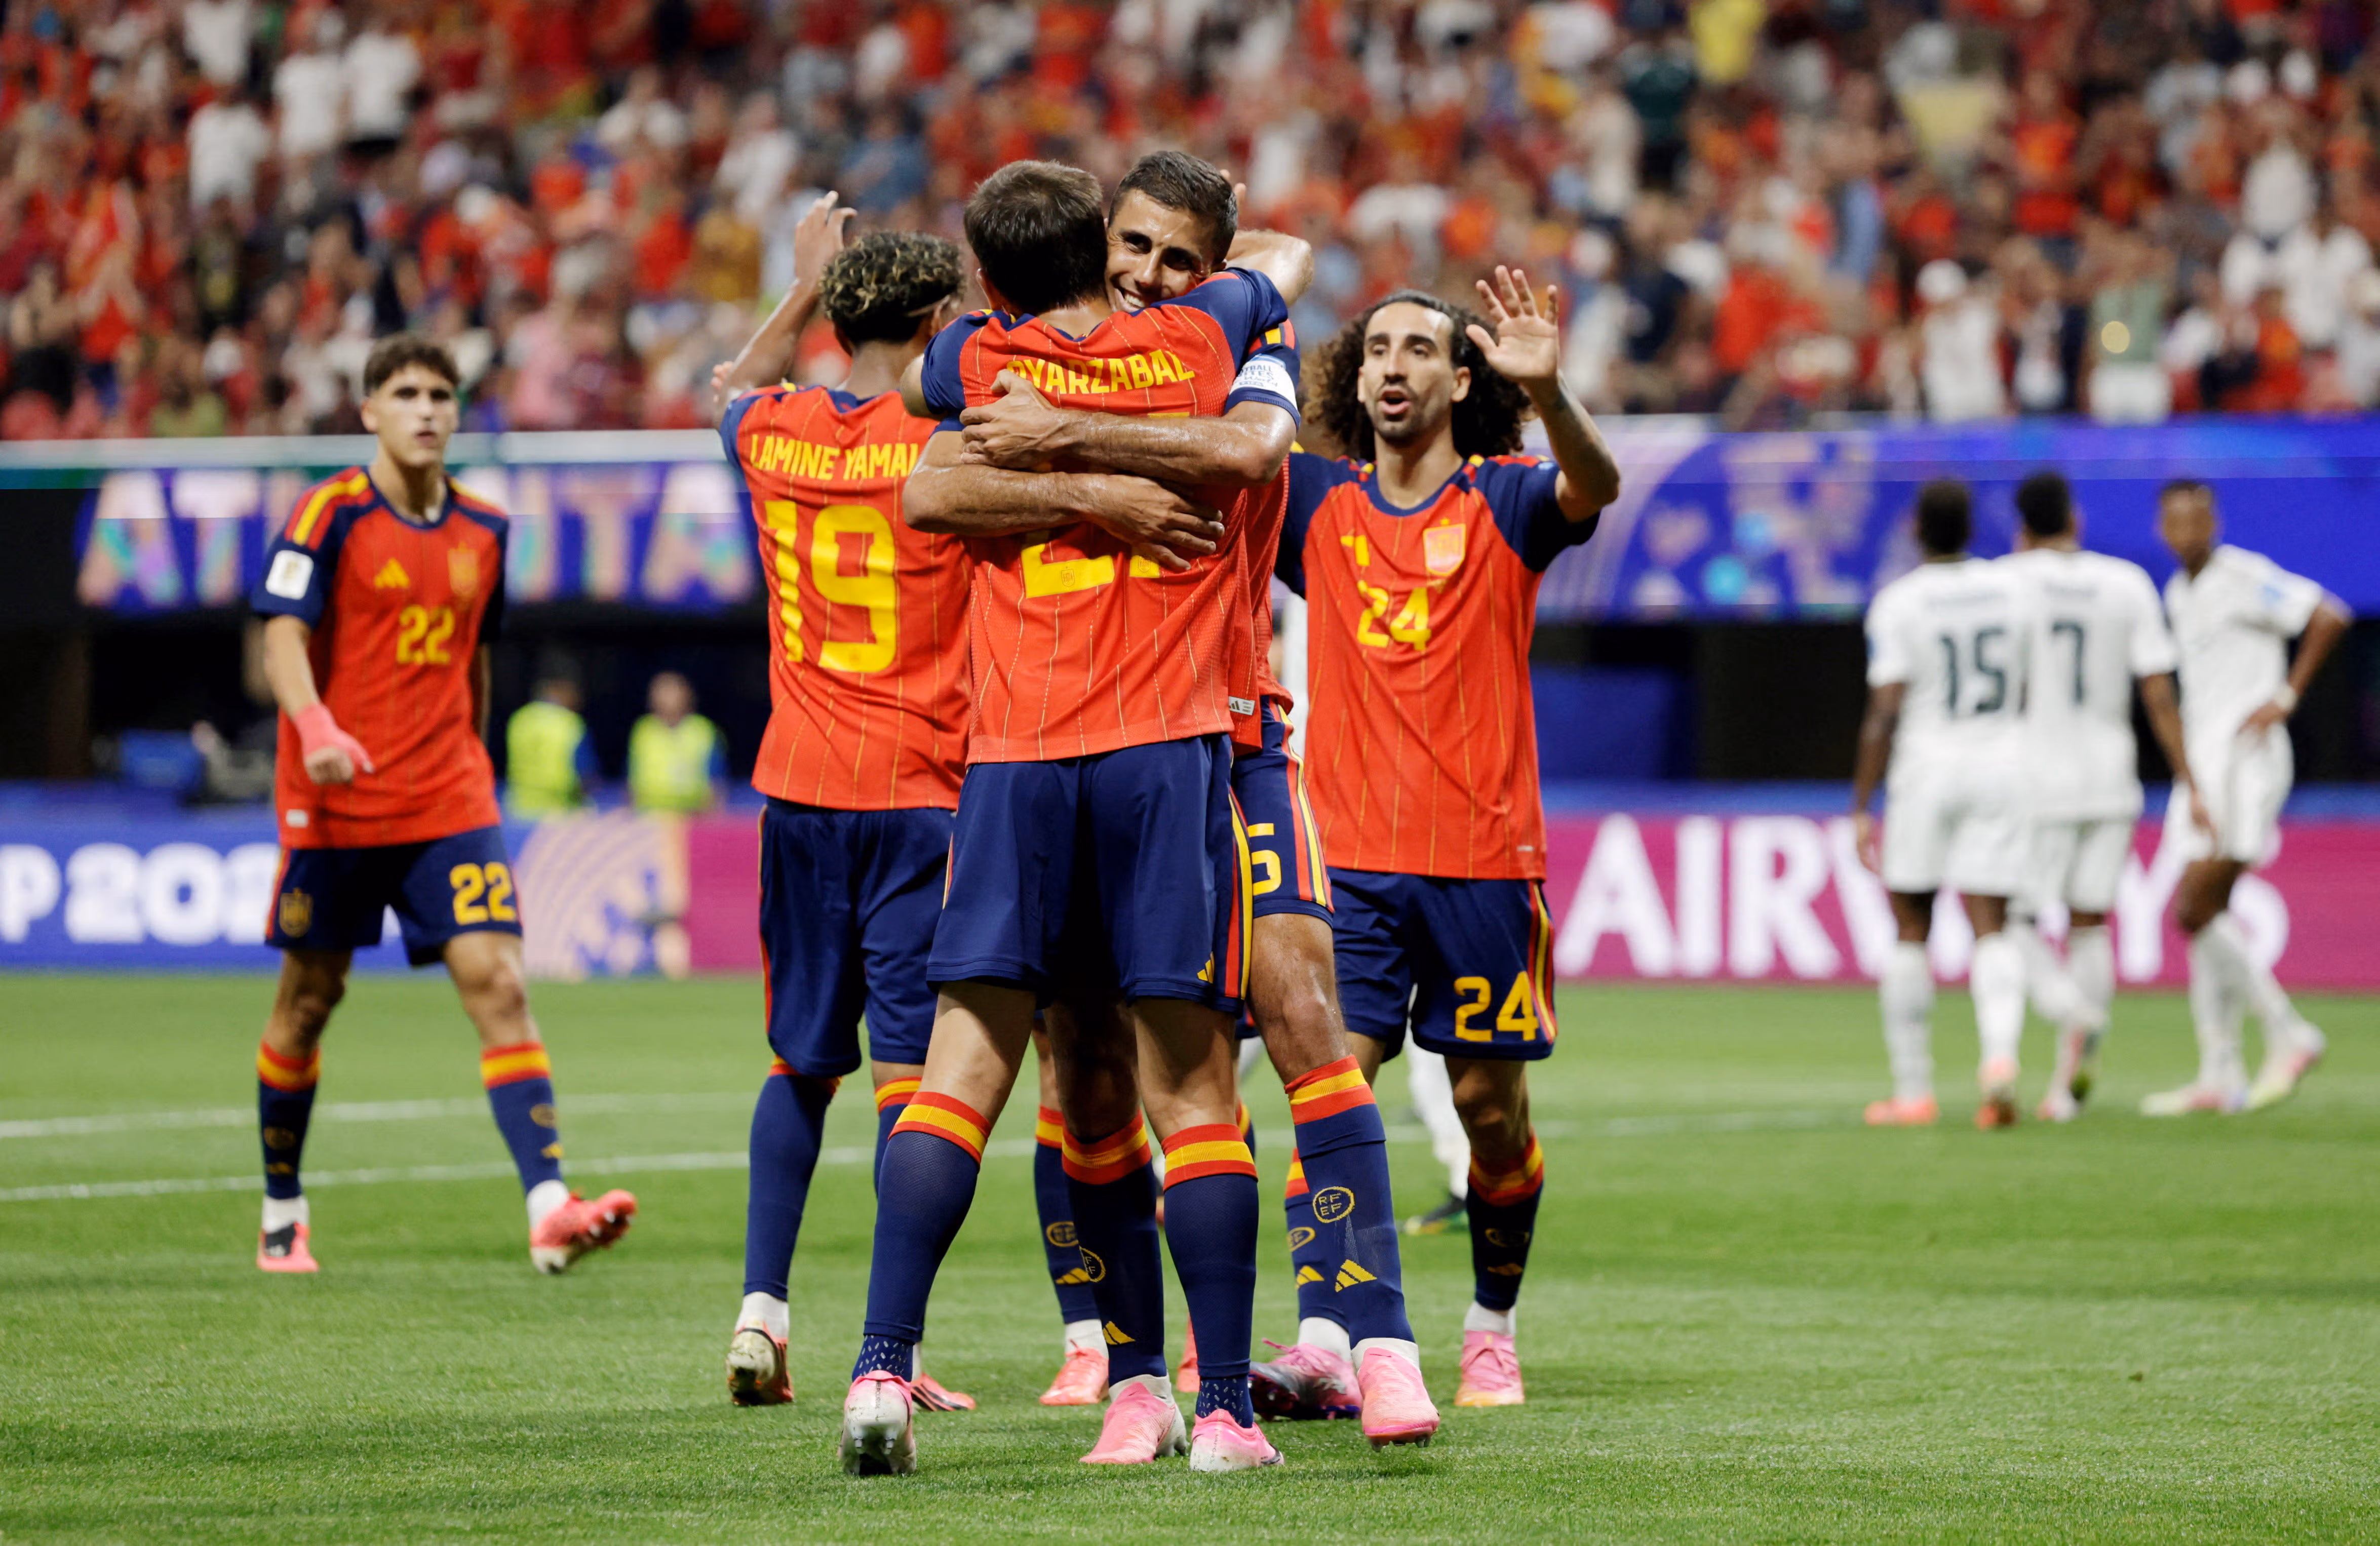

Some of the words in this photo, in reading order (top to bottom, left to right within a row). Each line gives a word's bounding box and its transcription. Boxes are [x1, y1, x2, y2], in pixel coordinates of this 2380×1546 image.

[751, 434, 840, 481] LAMINE
[764, 500, 896, 673] 19
[1357, 580, 1431, 650] 24
[397, 604, 454, 664] 22
[2051, 620, 2086, 704] 7
[1940, 626, 2009, 720] 15
[64, 842, 403, 945] 202
[449, 862, 517, 926] 22
[1550, 812, 2289, 983] AIRWYS
[1454, 971, 1540, 1042] 24
